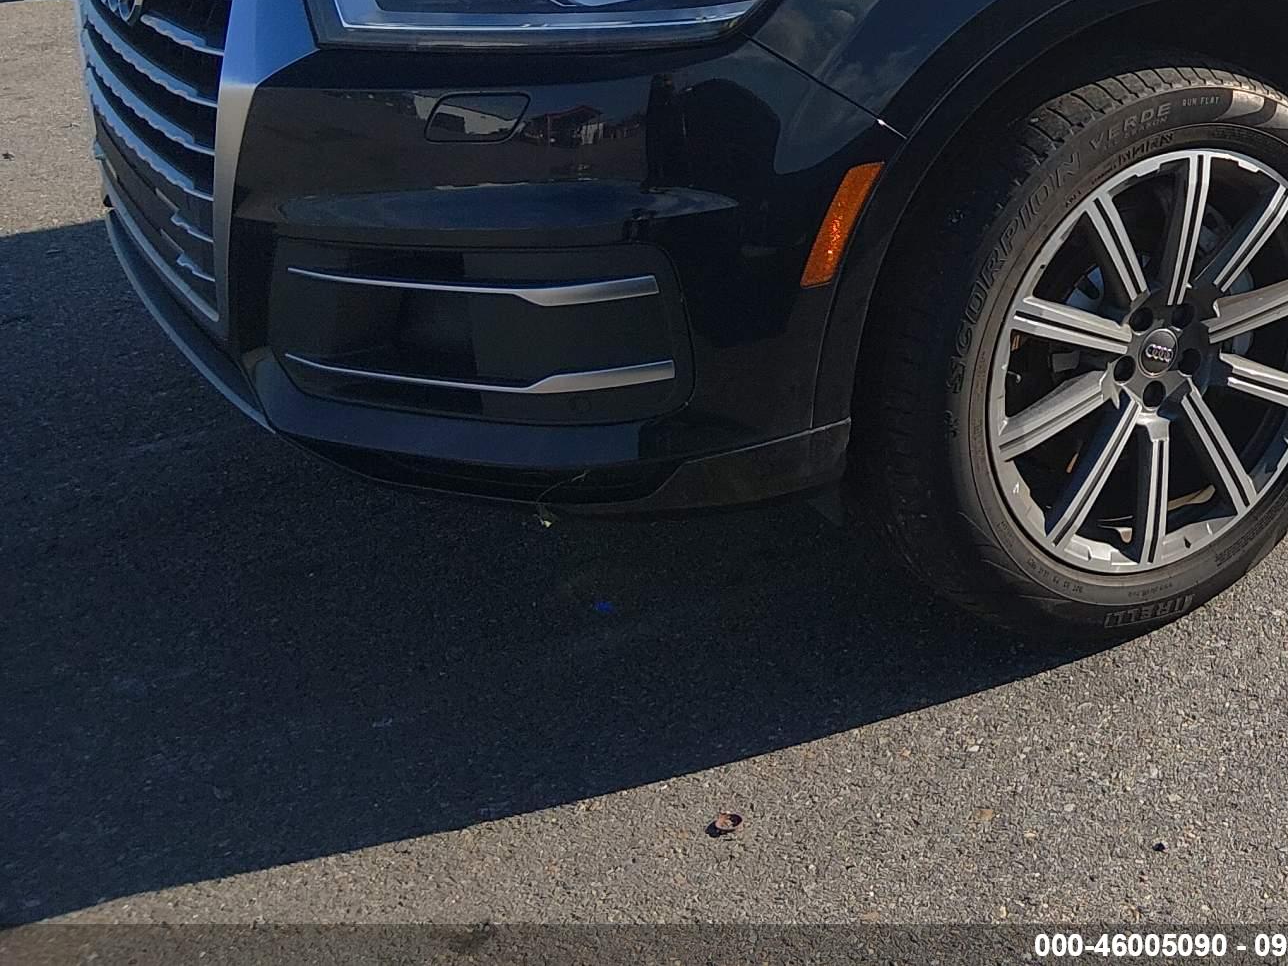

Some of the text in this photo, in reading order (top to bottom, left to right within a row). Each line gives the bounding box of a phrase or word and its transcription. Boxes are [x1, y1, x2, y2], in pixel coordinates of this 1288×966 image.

[948, 151, 1081, 394] SCORPION
[1088, 102, 1172, 151] VERDE
[1182, 97, 1197, 107] RUN
[1200, 95, 1220, 105] FLAT
